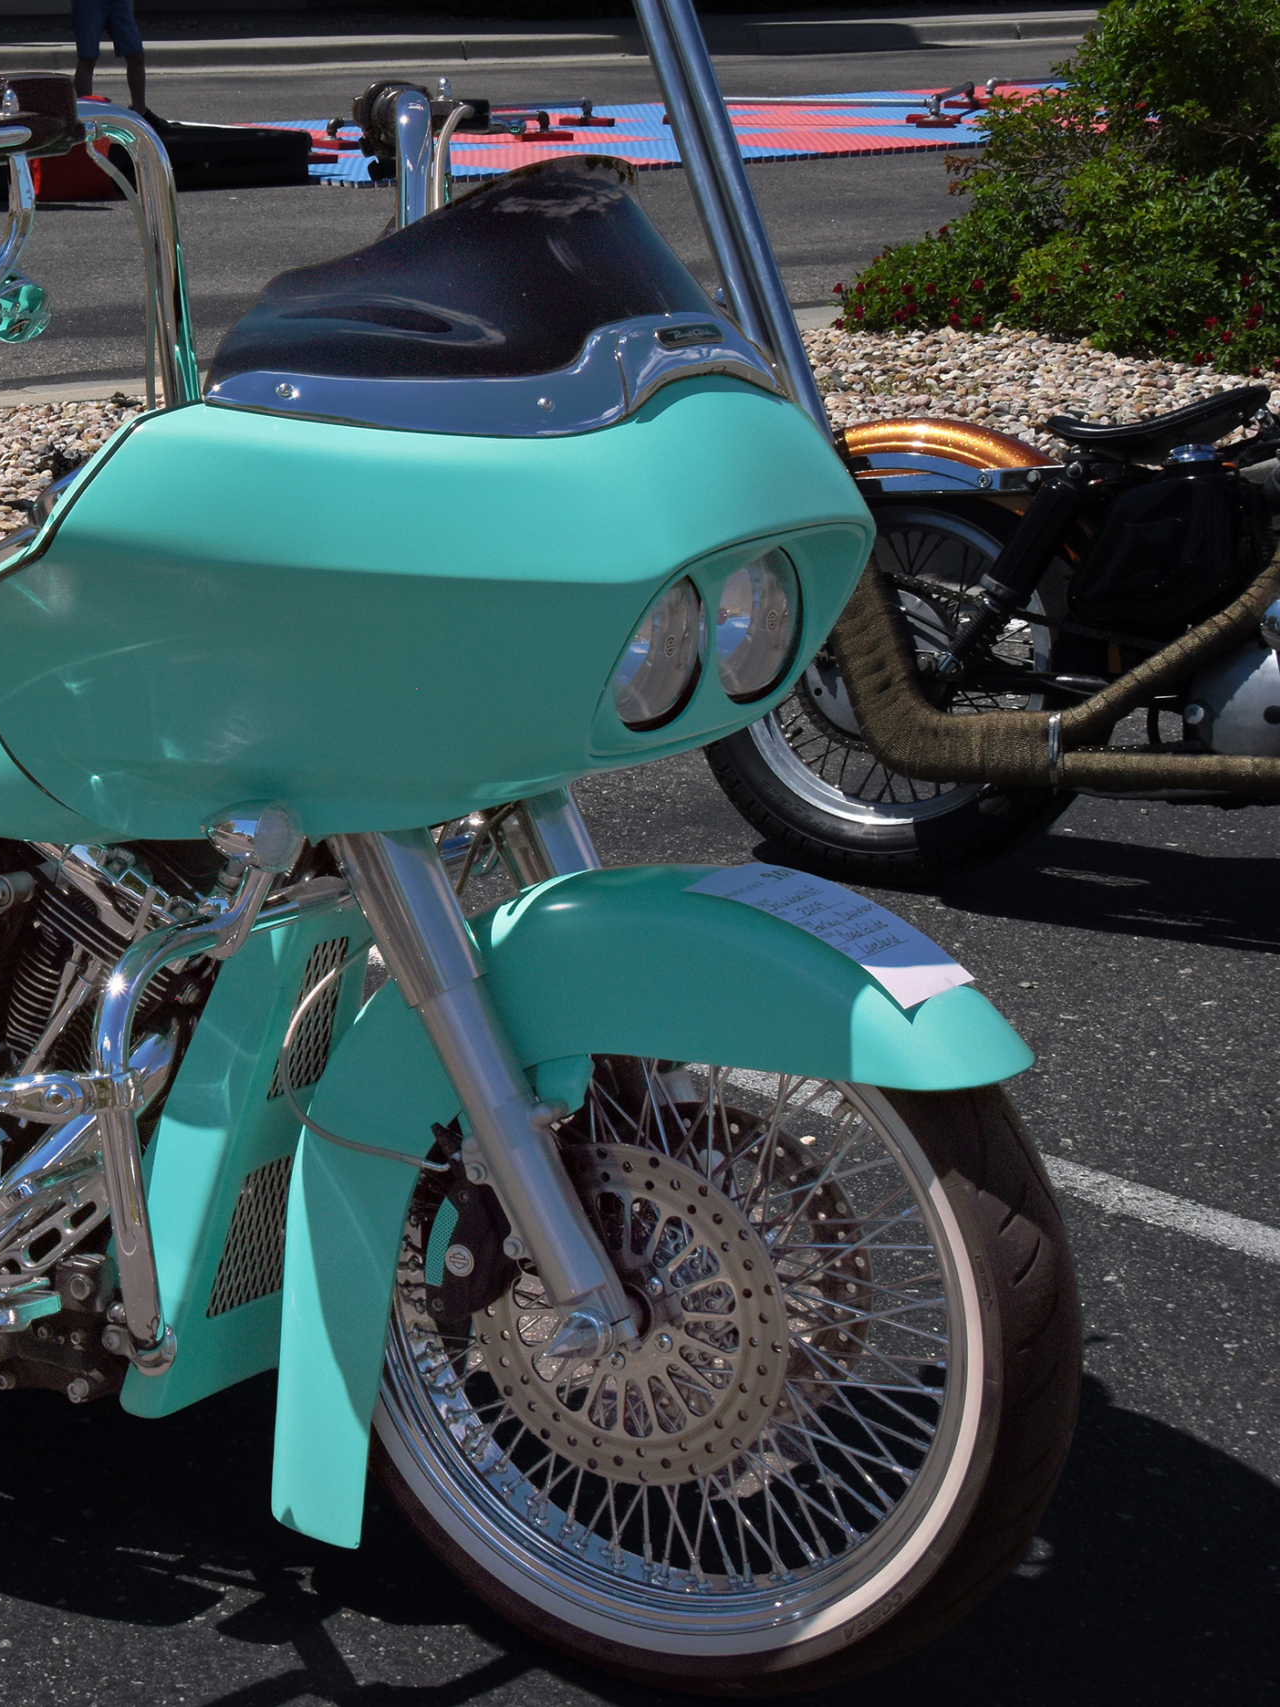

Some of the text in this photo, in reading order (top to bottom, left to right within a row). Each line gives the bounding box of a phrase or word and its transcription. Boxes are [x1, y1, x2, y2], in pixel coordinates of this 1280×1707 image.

[797, 901, 828, 917] 2009
[854, 932, 901, 954] Loveland
[842, 1588, 904, 1640] COBRA
